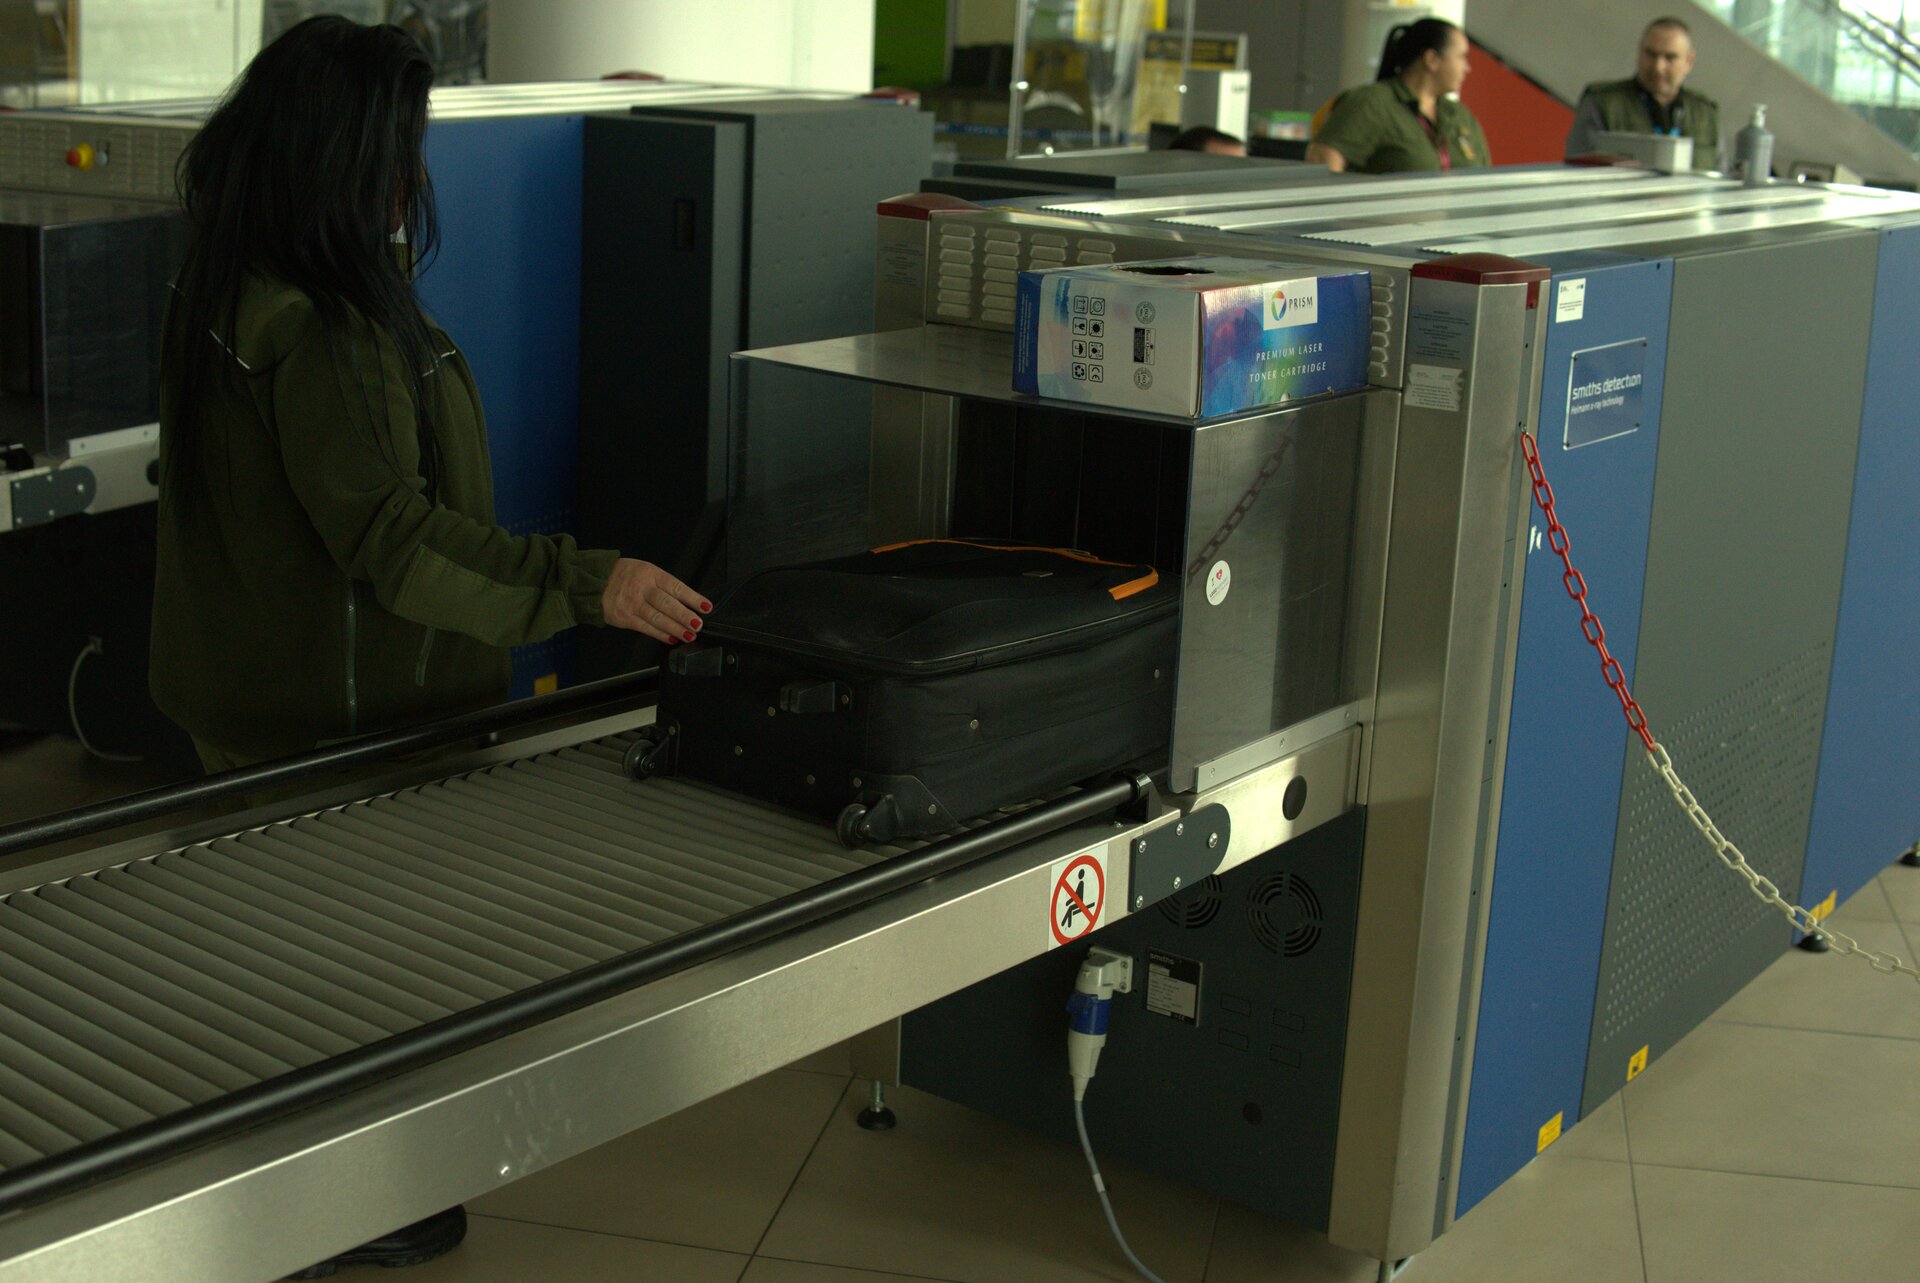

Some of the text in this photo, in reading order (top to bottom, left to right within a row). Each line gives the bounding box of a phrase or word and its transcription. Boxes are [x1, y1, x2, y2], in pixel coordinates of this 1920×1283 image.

[1288, 296, 1313, 310] PRISM
[1256, 342, 1323, 362] PREMIUM LASER
[1249, 361, 1327, 383] TONER CARTRIDGE
[1572, 373, 1642, 400] smiths detection
